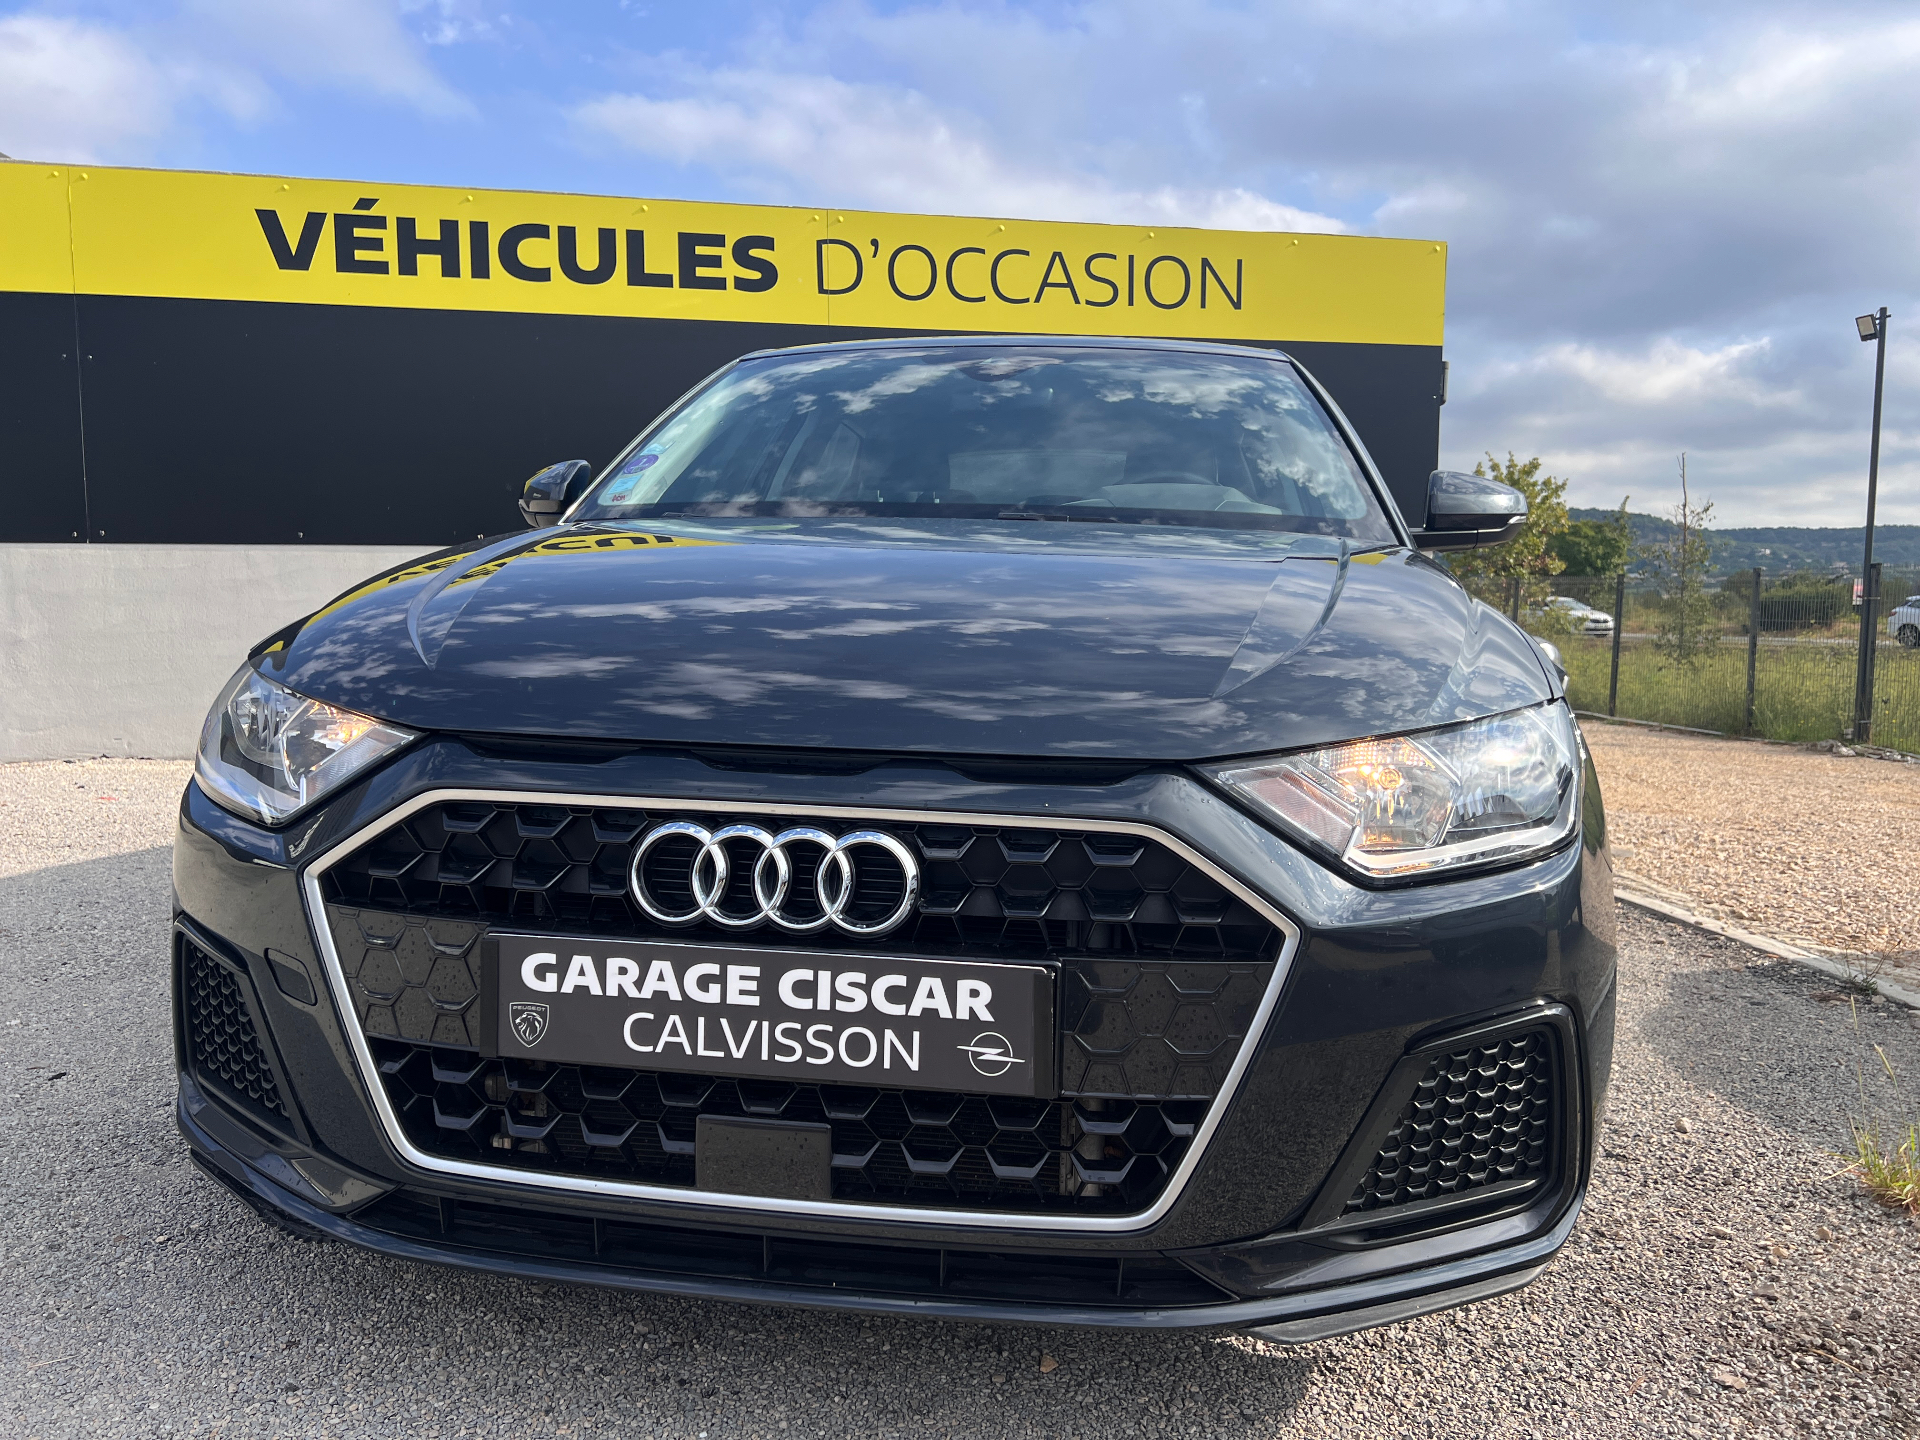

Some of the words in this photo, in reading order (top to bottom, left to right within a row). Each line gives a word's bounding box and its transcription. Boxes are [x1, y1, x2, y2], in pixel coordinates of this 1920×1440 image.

[254, 197, 779, 293] VÉHICULES
[520, 952, 761, 1007] GARAGE
[778, 968, 995, 1022] CISCAR
[623, 1011, 920, 1072] CALVISSON
